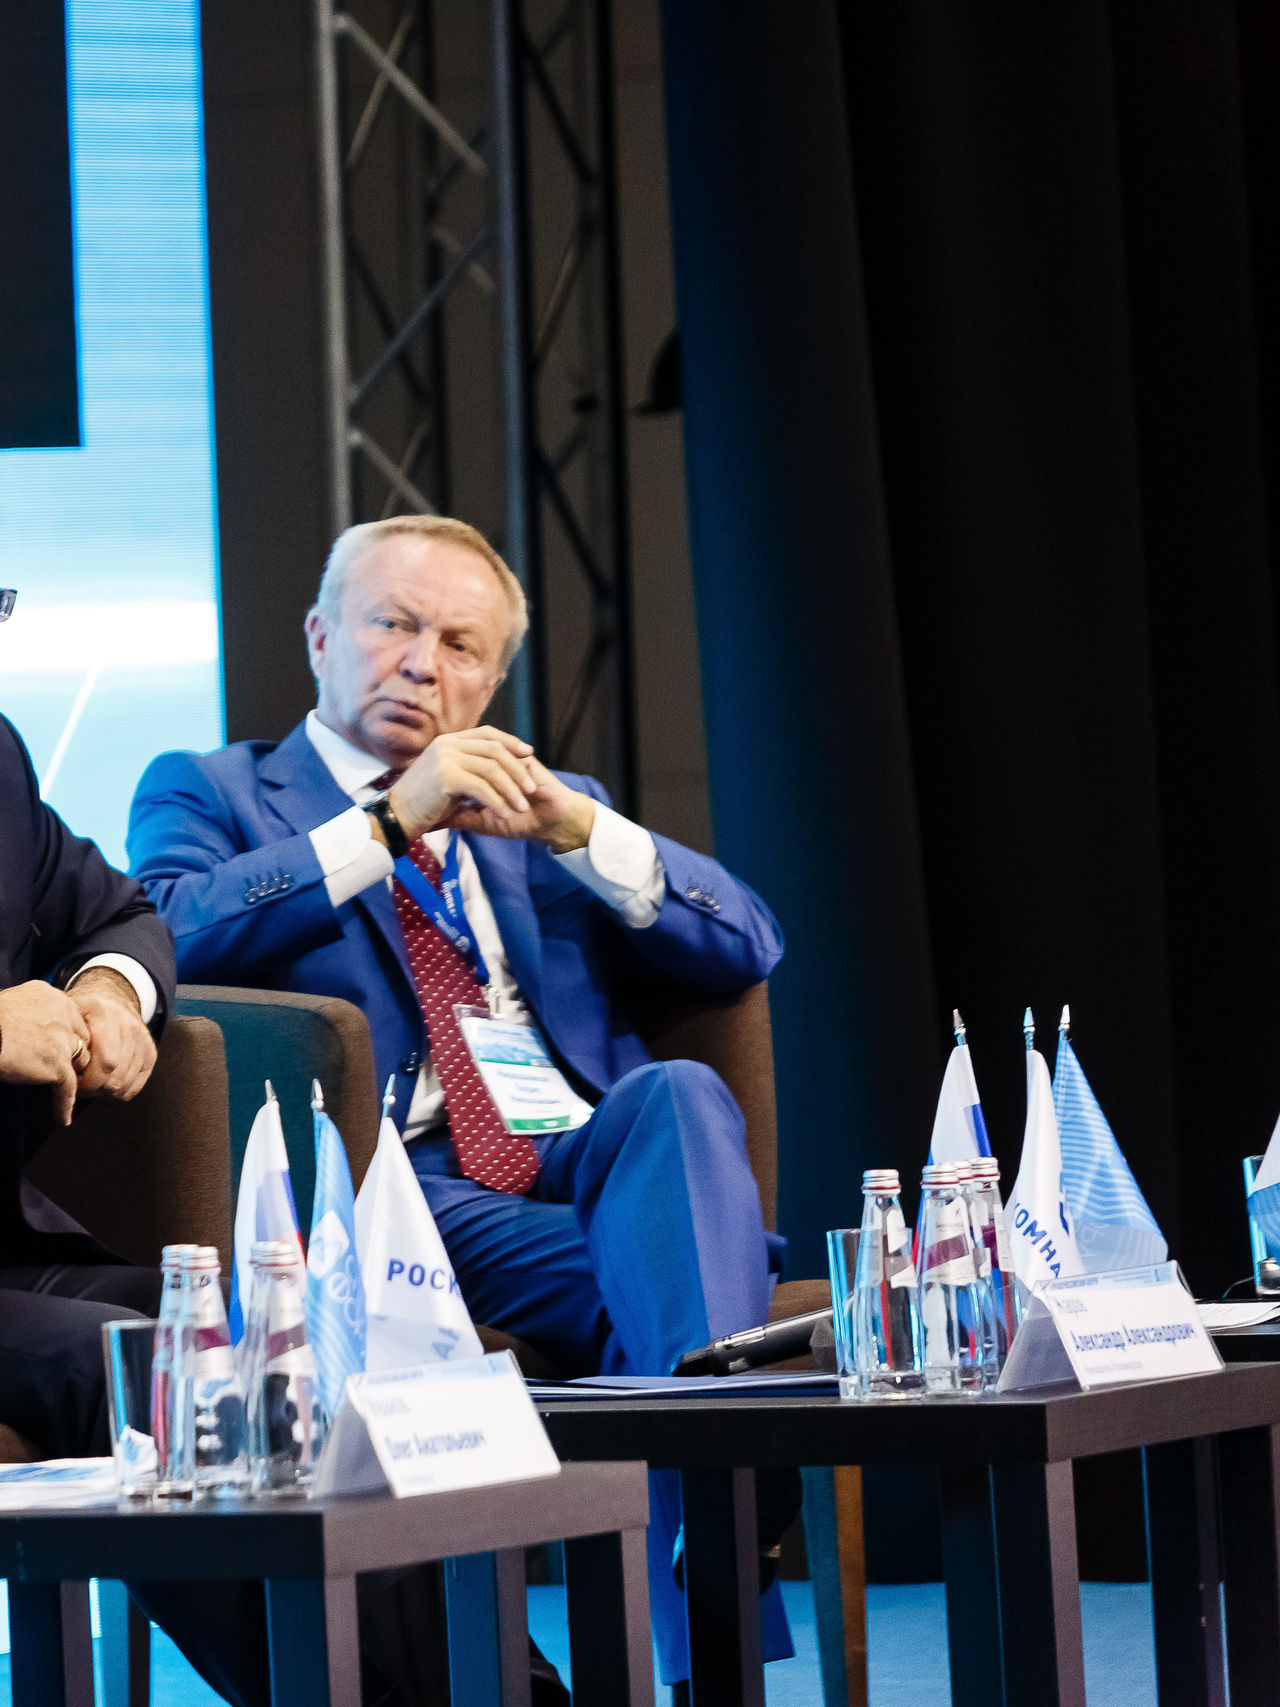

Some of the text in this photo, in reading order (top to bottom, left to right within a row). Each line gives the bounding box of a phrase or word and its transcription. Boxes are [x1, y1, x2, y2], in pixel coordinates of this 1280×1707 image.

[1014, 1202, 1061, 1279] ОМНА
[1070, 1324, 1197, 1352] Александр Александрович
